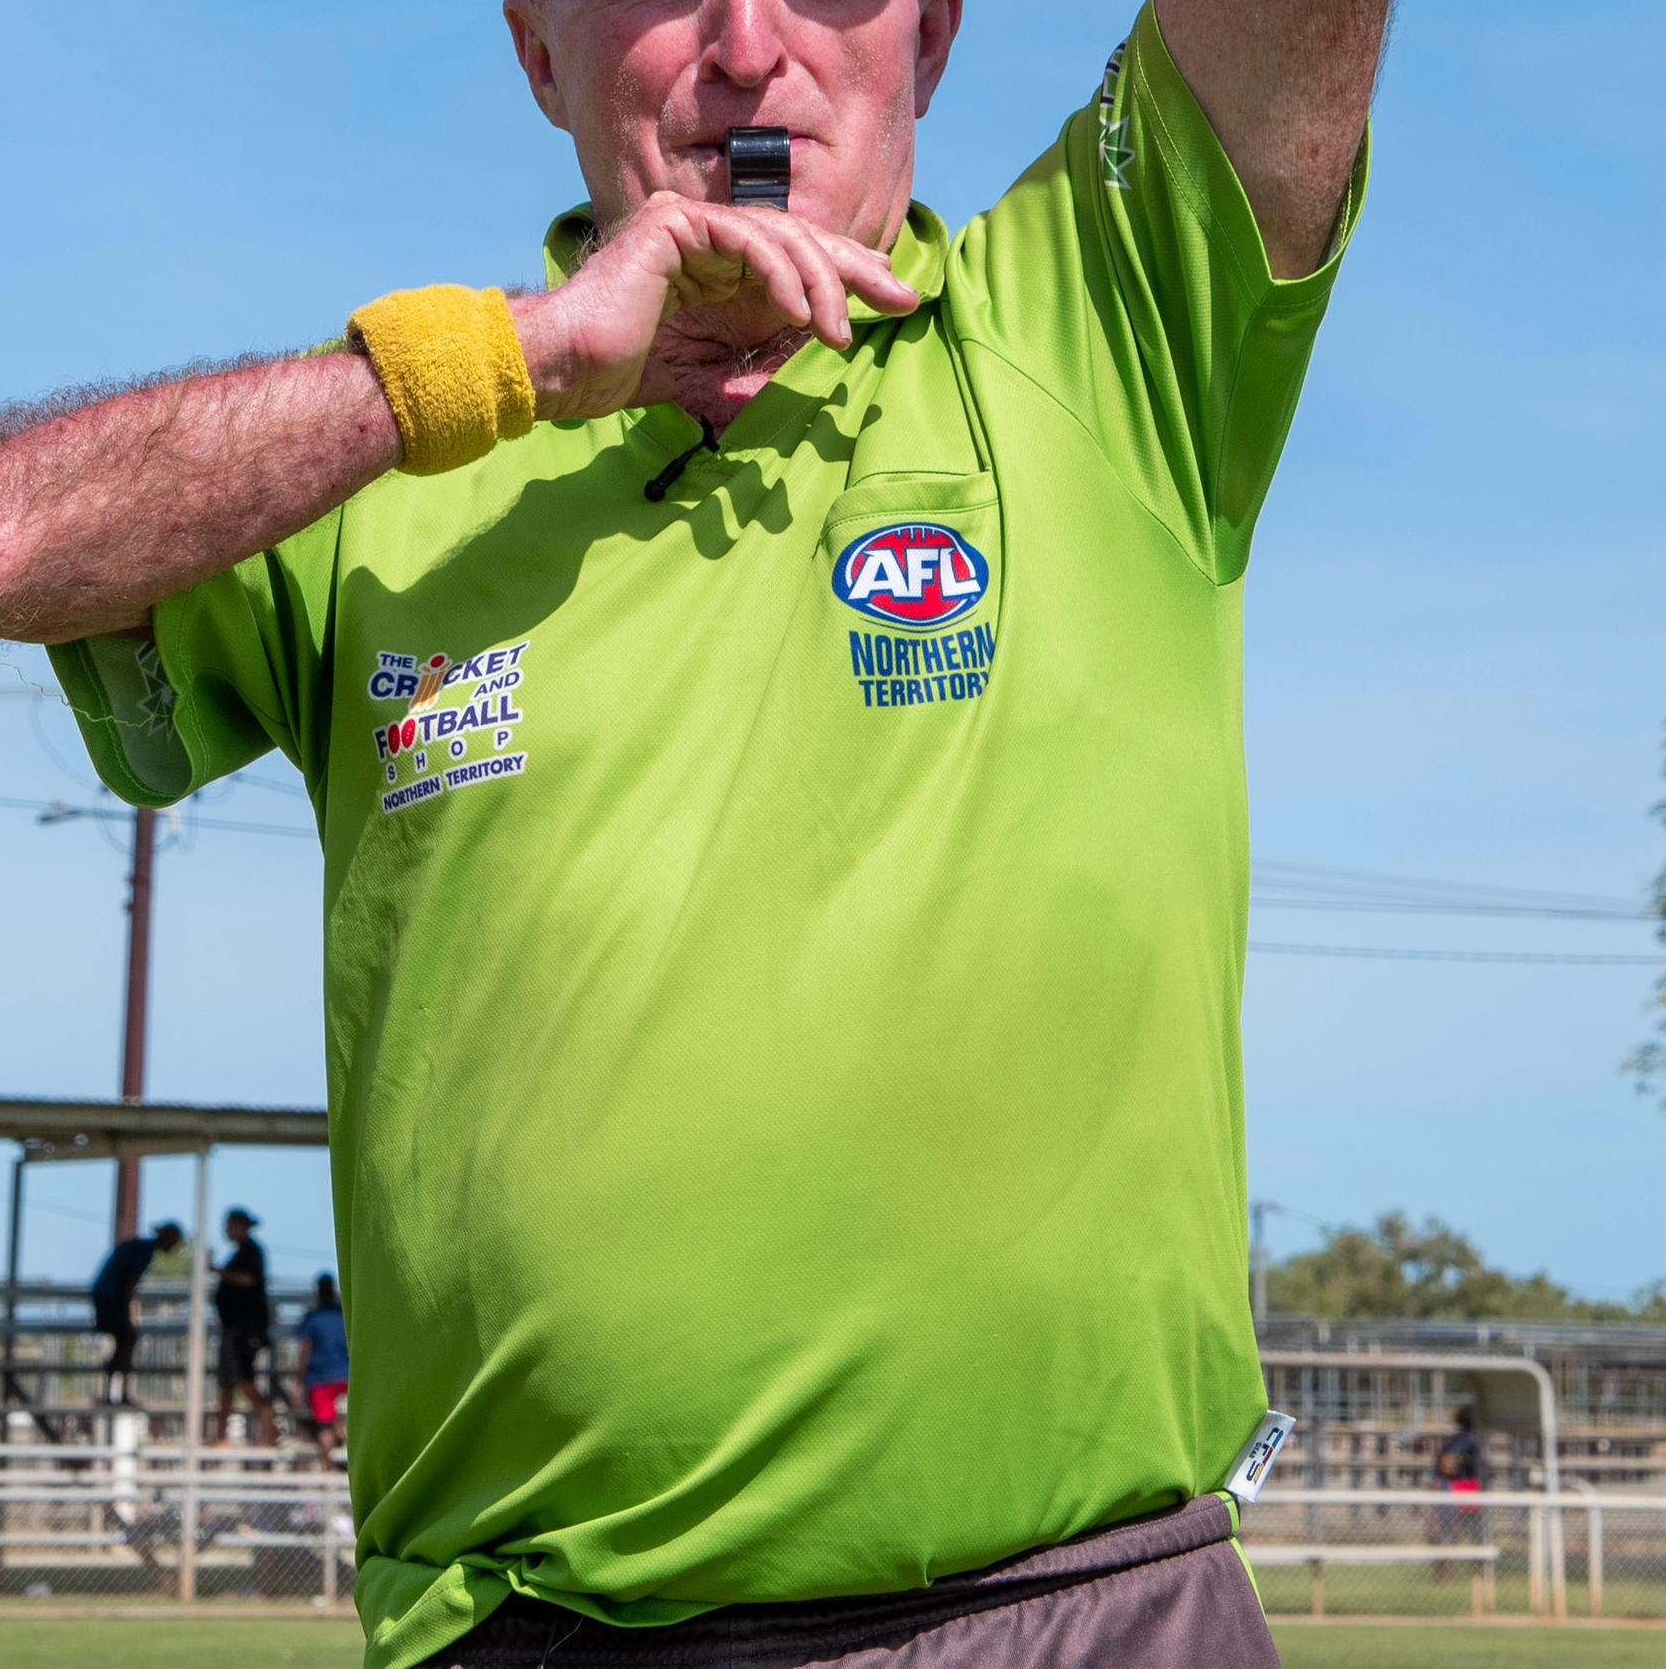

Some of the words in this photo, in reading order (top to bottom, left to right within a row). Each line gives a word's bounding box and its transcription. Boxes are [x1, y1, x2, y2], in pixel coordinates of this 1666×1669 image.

[848, 547, 981, 600] AFL
[380, 654, 414, 669] THE
[849, 621, 995, 677] NORTHERN
[473, 671, 520, 698] AND
[375, 696, 519, 760] FOOTBALL
[383, 776, 441, 811] NORTHERN
[445, 755, 525, 787] TERRITORY
